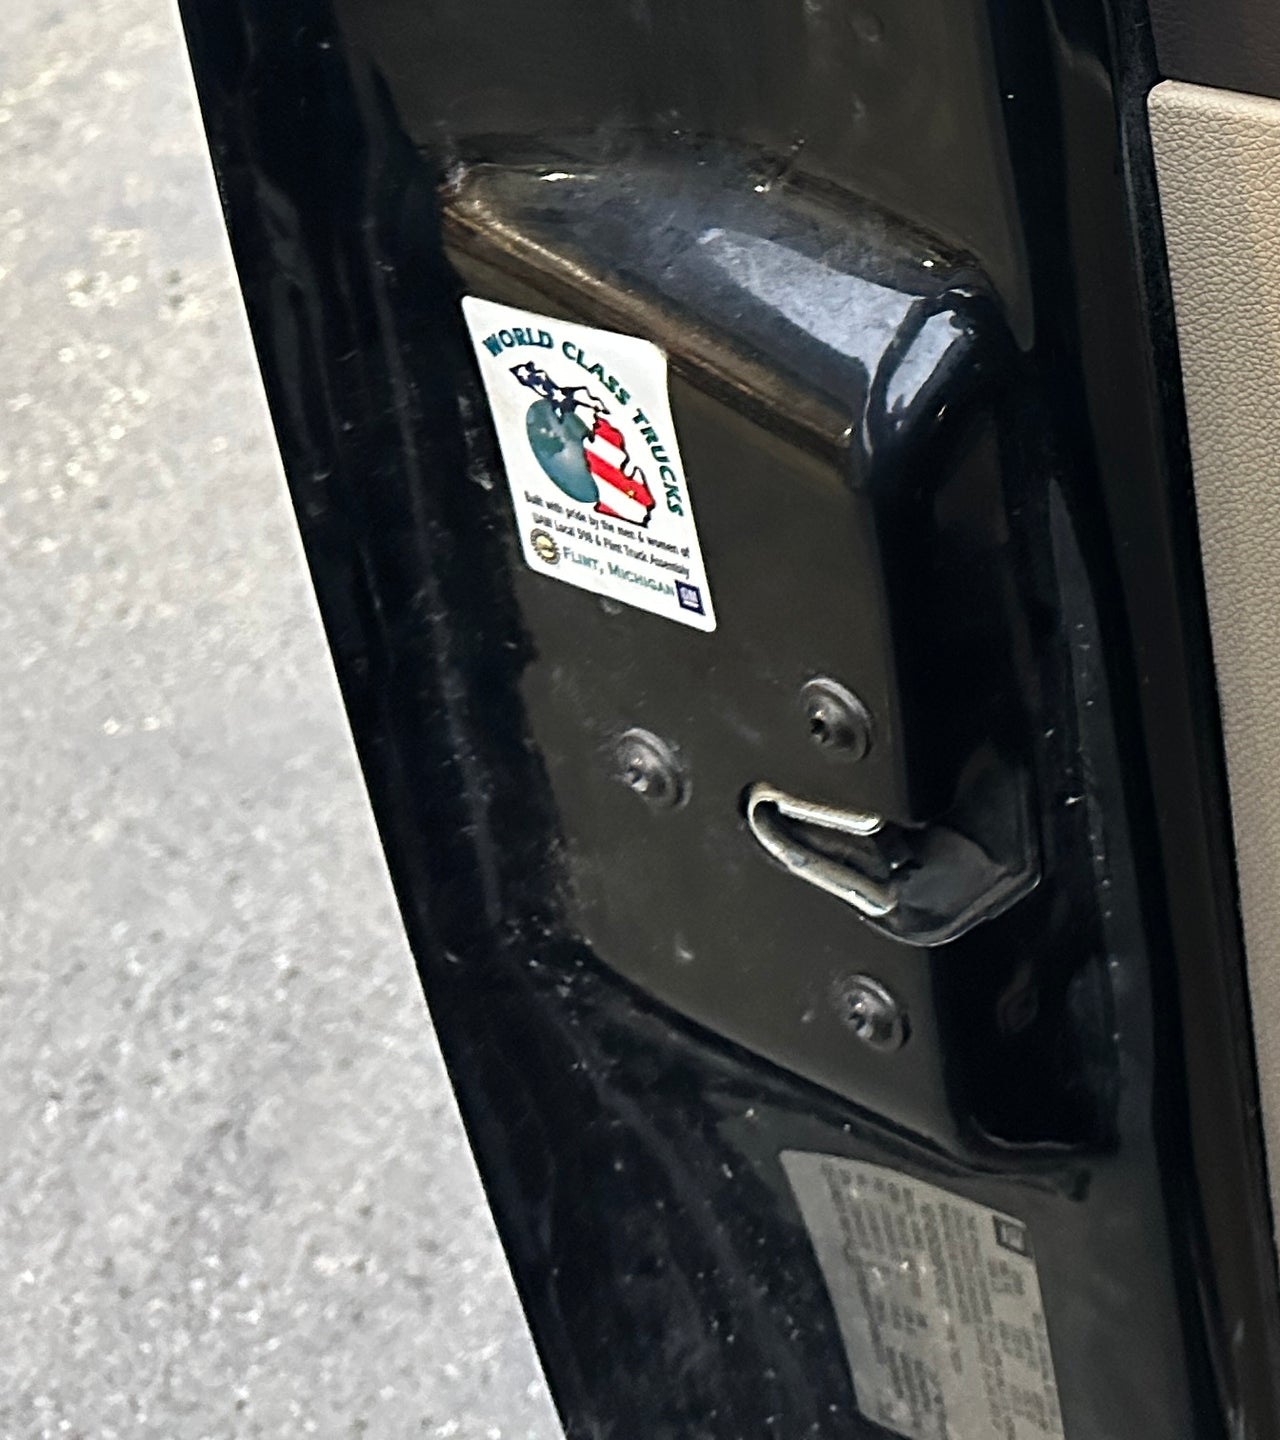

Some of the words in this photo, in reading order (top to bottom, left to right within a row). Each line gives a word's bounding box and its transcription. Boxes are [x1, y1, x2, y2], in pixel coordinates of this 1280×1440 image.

[482, 327, 553, 357] WORLD
[562, 341, 631, 406] CLASS
[634, 409, 684, 517] TRUCKS
